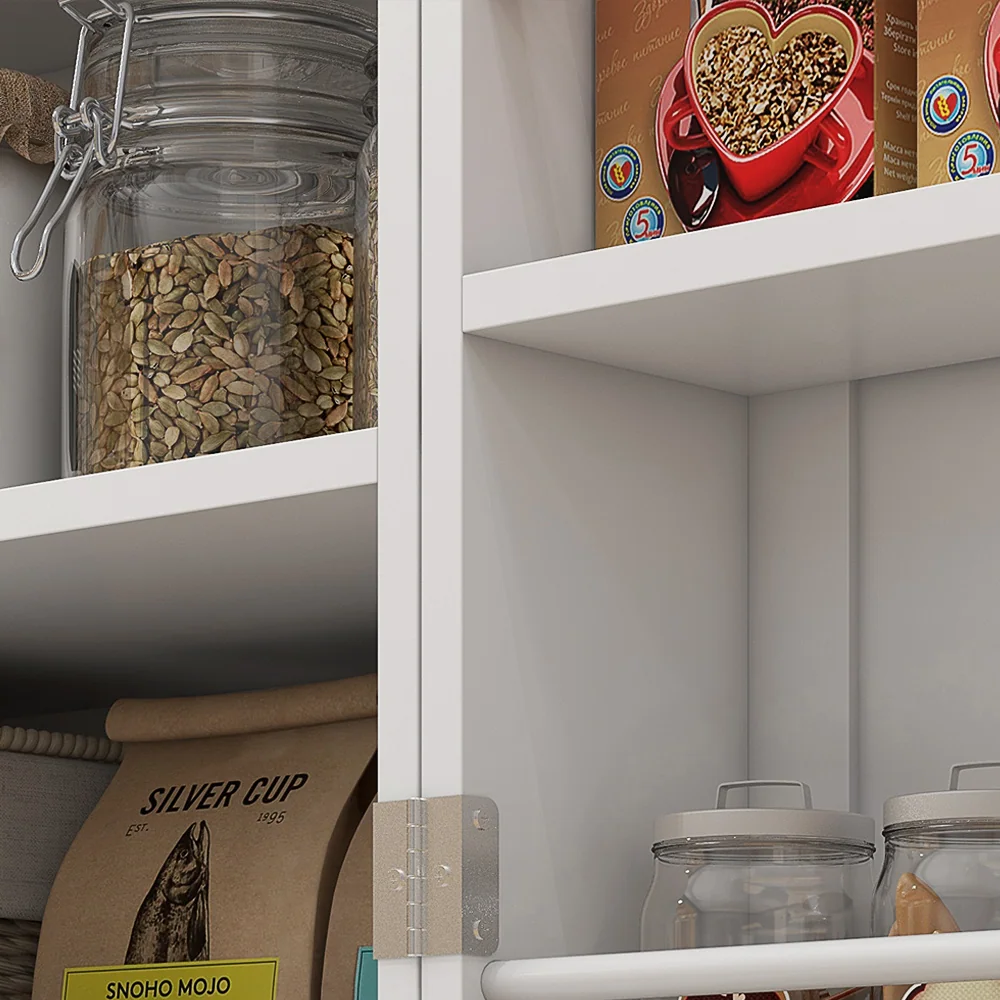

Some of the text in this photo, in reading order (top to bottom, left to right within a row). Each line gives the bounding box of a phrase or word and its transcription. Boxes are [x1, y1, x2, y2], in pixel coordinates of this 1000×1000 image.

[961, 143, 978, 176] 5
[635, 208, 650, 239] 5
[140, 773, 310, 816] SILVER CUP
[125, 810, 287, 837] EST. 1995
[106, 976, 231, 1000] SNOHO MOJO
